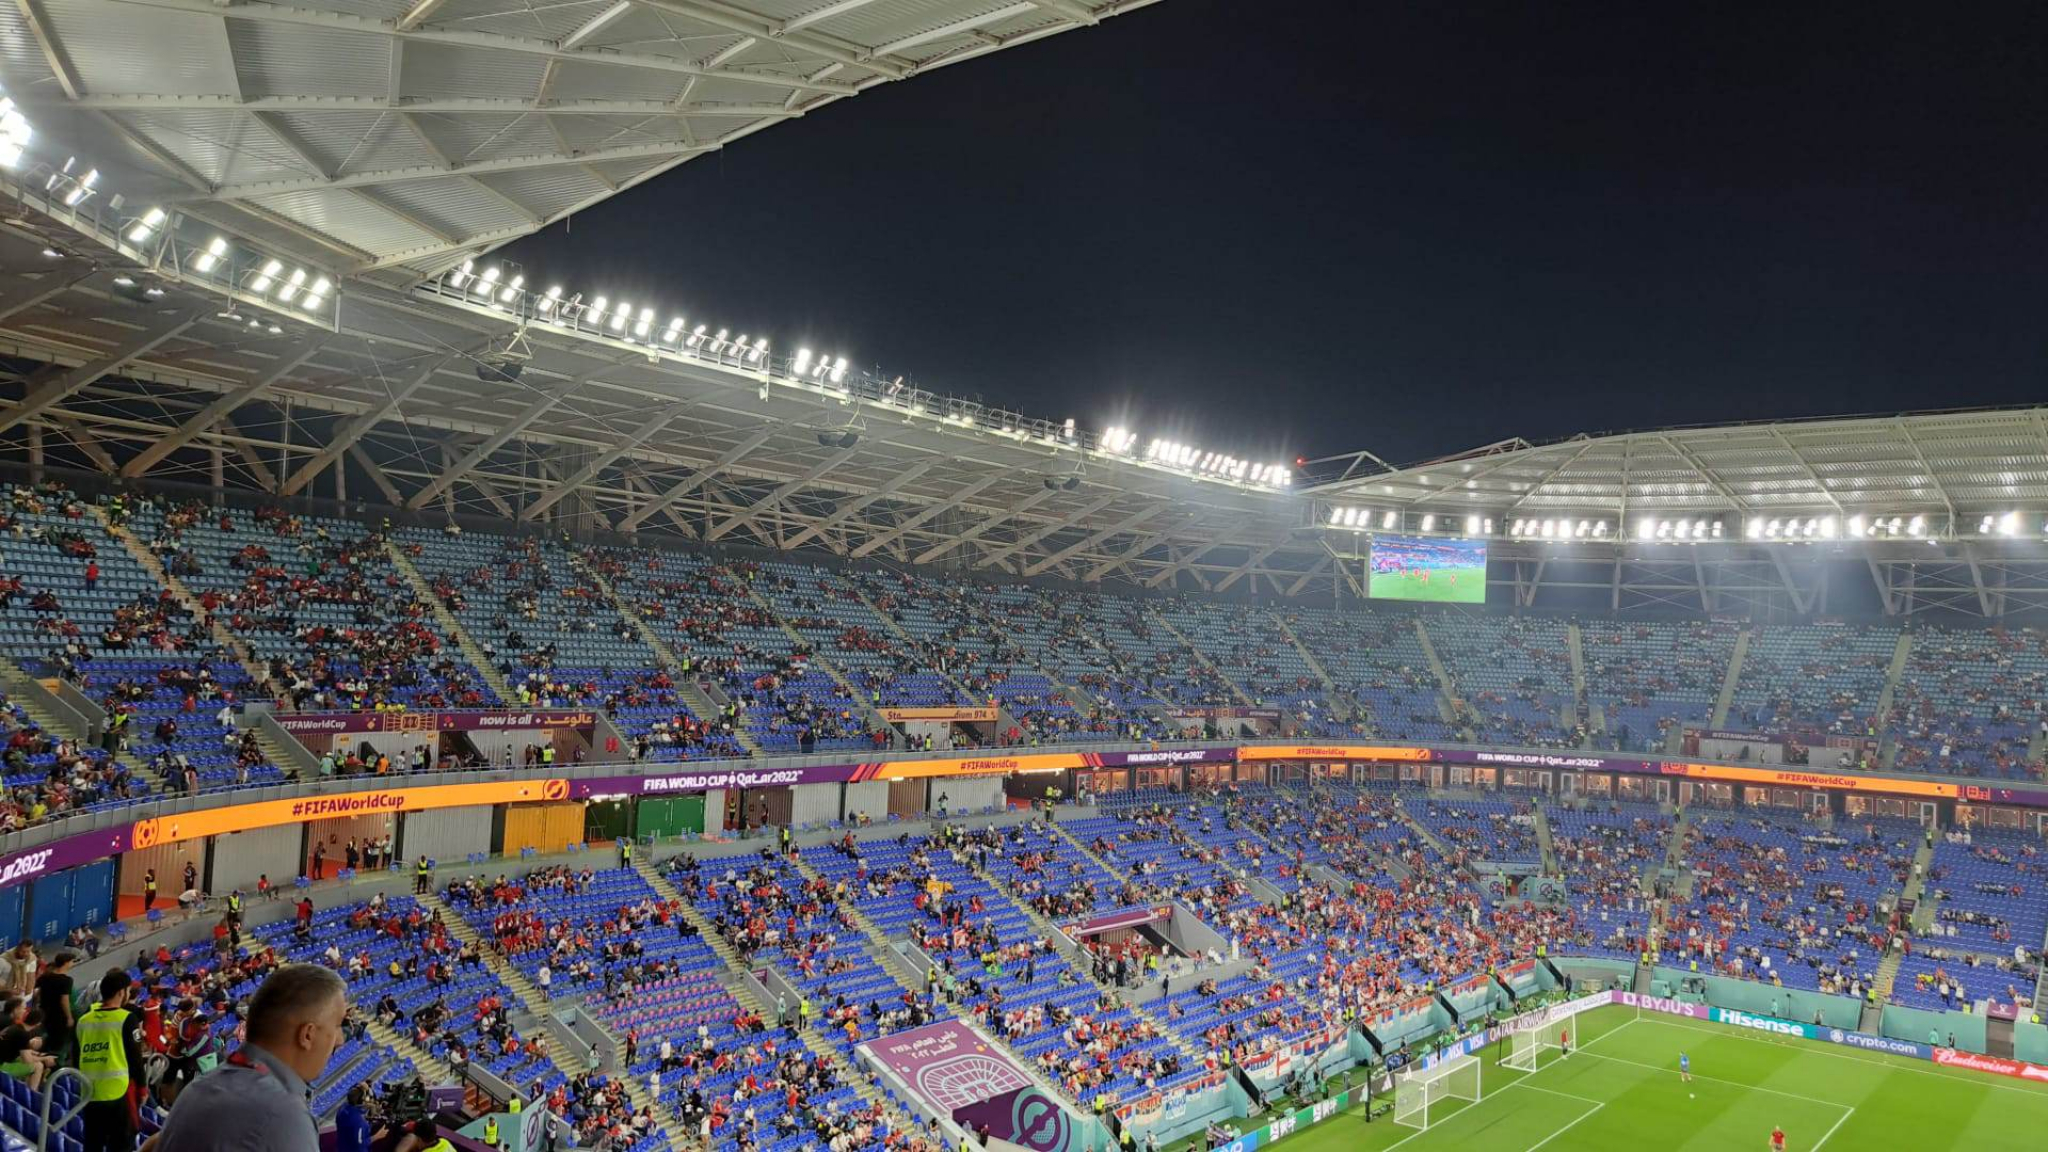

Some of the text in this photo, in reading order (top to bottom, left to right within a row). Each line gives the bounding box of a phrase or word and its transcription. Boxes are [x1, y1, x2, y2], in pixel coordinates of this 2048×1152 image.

[479, 713, 533, 726] now is all
[974, 710, 987, 719] 974
[960, 759, 1018, 770] #FIFAWorldCup
[1477, 753, 1494, 761] FIFA
[1494, 753, 1522, 763] WORLD
[1523, 755, 1538, 763] CUP
[643, 778, 668, 790] FIFA
[668, 776, 707, 789] WORLD
[708, 775, 729, 787] CUP
[1776, 773, 1857, 787] #FIFAWorldCup
[292, 794, 404, 816] #FIFAWorldCup
[1641, 995, 1694, 1017] BYJU'S
[1489, 1020, 1514, 1042] QATAR
[1719, 1008, 1804, 1037] Hisense
[1447, 1040, 1465, 1060] VISA
[1468, 1032, 1485, 1052] VISA
[1846, 1034, 1917, 1055] crypto.com
[1934, 1047, 2016, 1074] Budweiser
